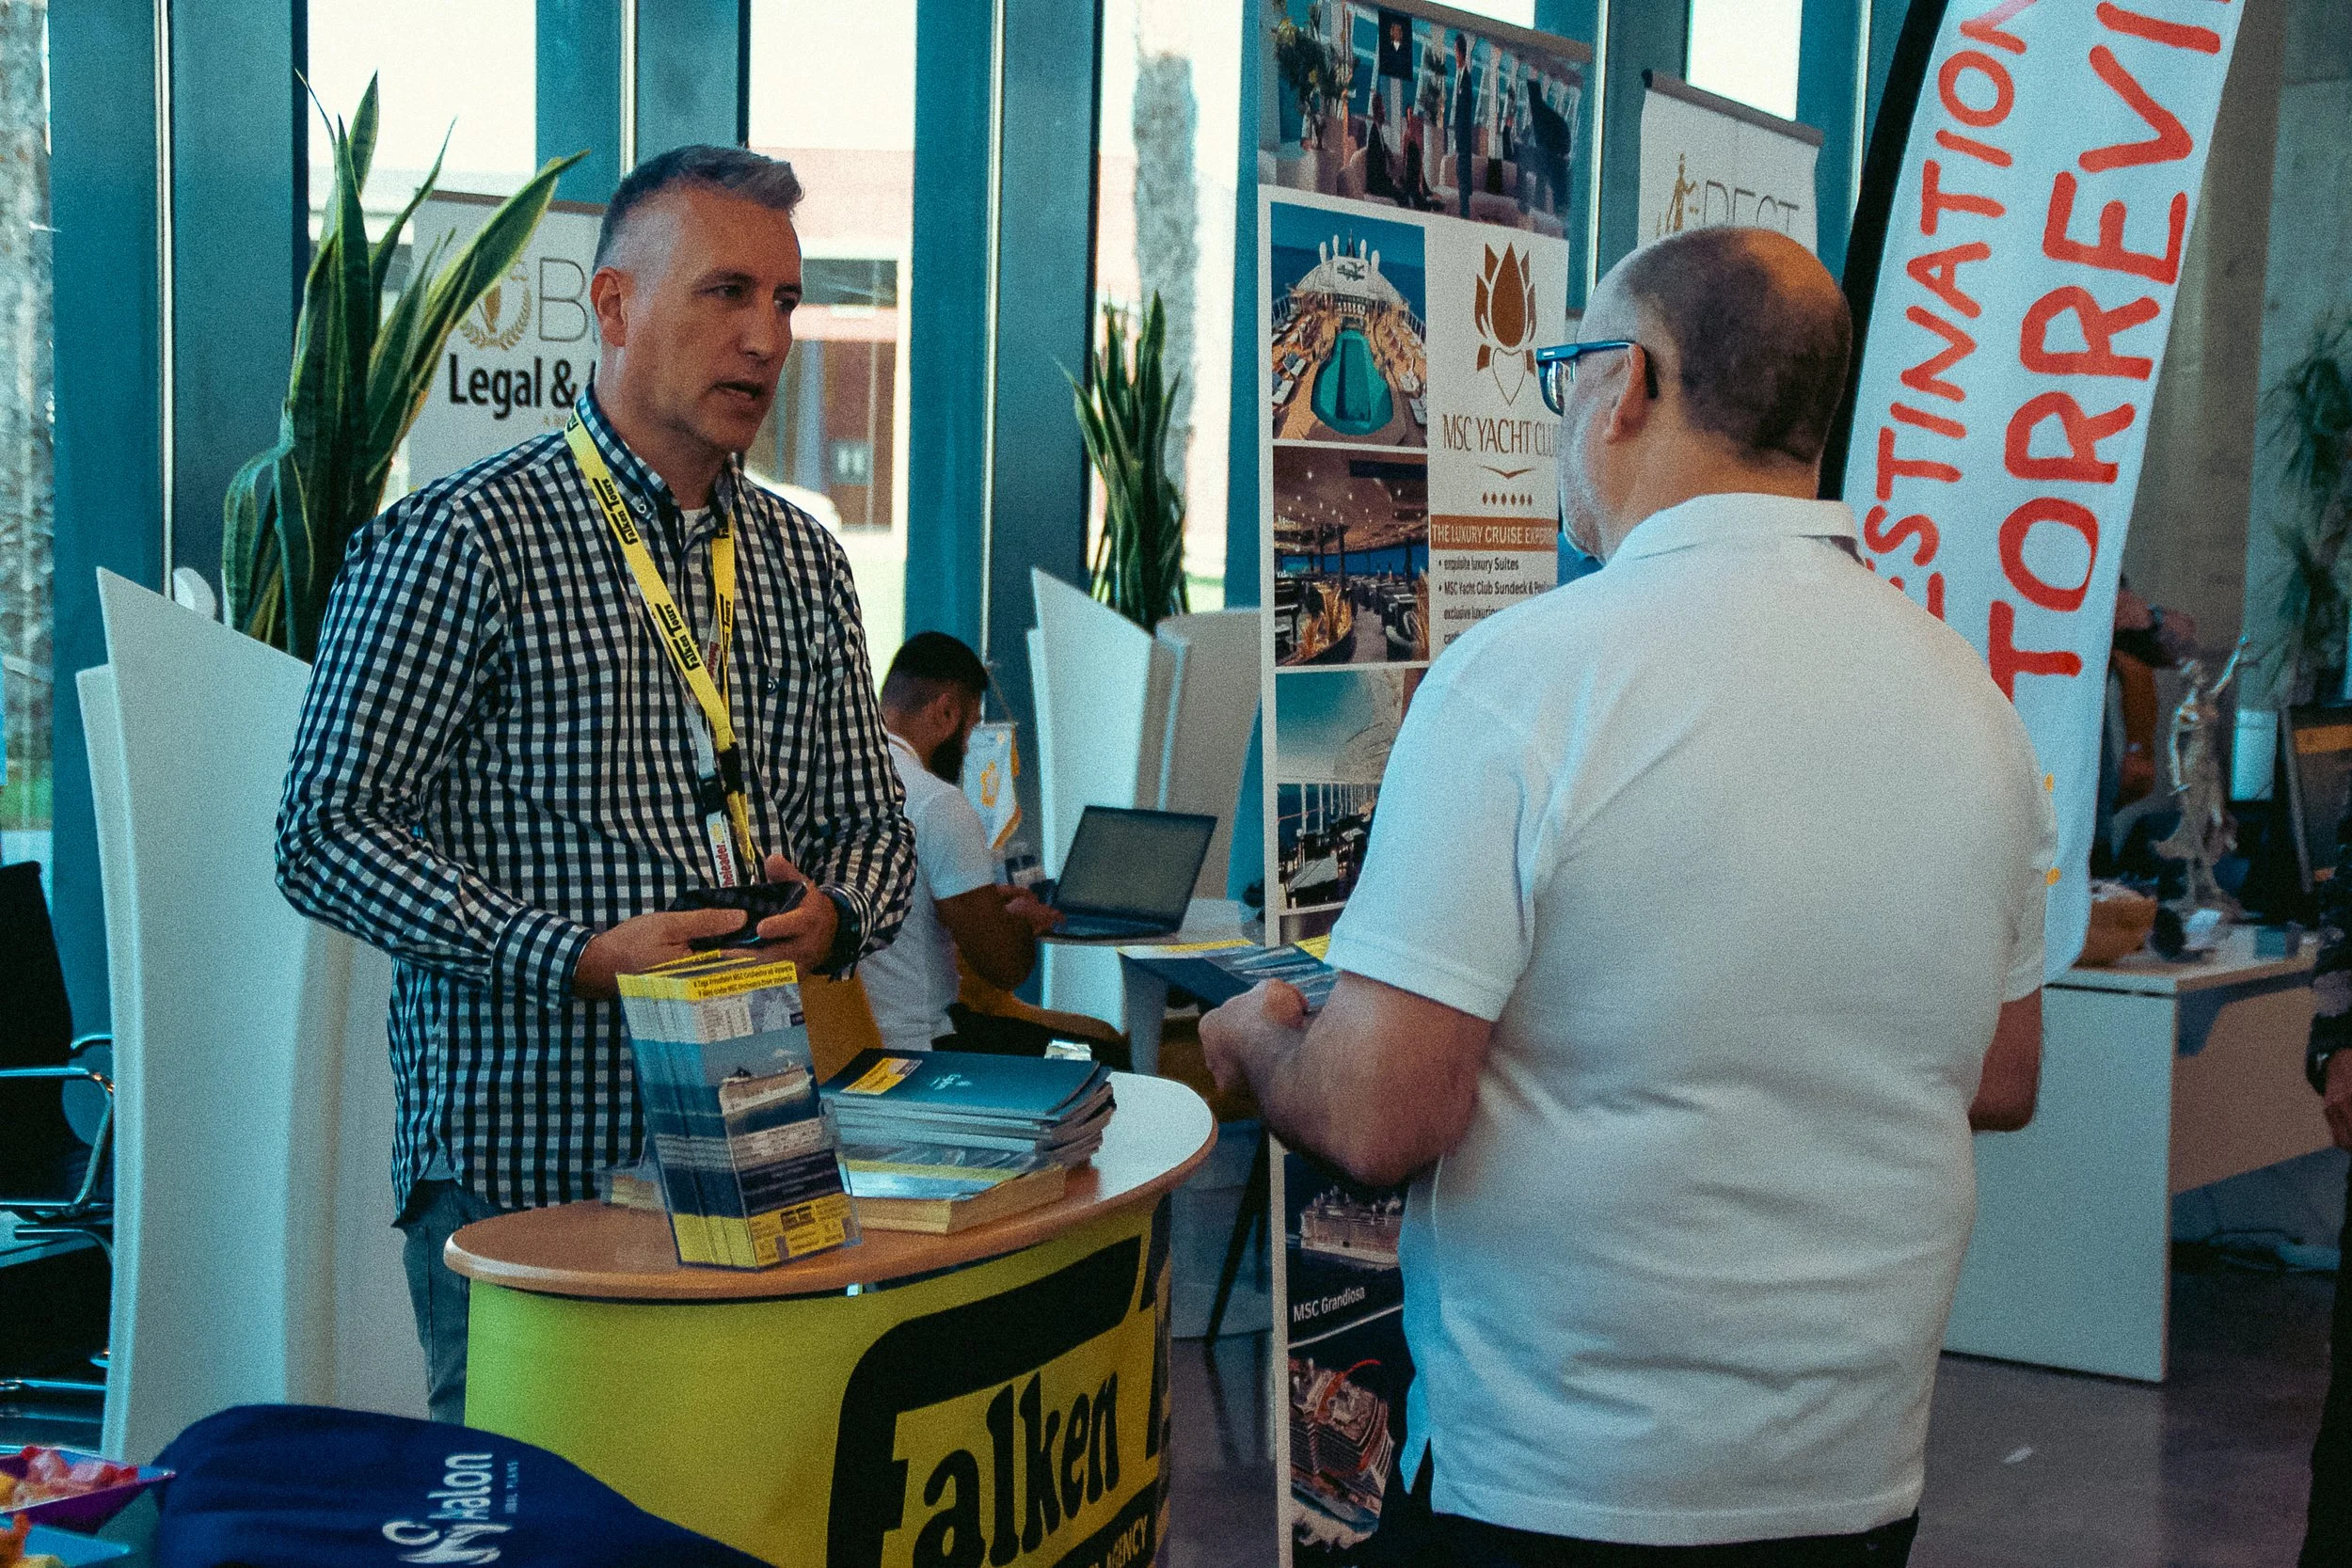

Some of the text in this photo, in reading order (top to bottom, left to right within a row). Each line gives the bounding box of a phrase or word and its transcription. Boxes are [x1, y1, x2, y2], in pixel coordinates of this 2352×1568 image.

[1864, 0, 2038, 622] STINATION
[1988, 0, 2232, 705] TORREVI
[449, 353, 578, 420] Legal &
[1443, 414, 1471, 451] MSC
[1475, 417, 1531, 455] YACHT
[592, 478, 639, 545] Falken Tours
[1432, 524, 1449, 543] THE
[1451, 525, 1484, 544] LUXURY
[1485, 526, 1523, 544] CRUISE
[1444, 581, 1458, 595] MSC
[1459, 581, 1475, 595] Yacht
[1476, 580, 1493, 595] Club
[1494, 581, 1527, 595] Sundeck
[1471, 556, 1493, 574] luxury
[1494, 557, 1519, 571] Suites
[656, 603, 701, 671] Falken Tours
[1294, 1287, 1365, 1323] MSC Grandiosa
[825, 1234, 1142, 1568] Falken
